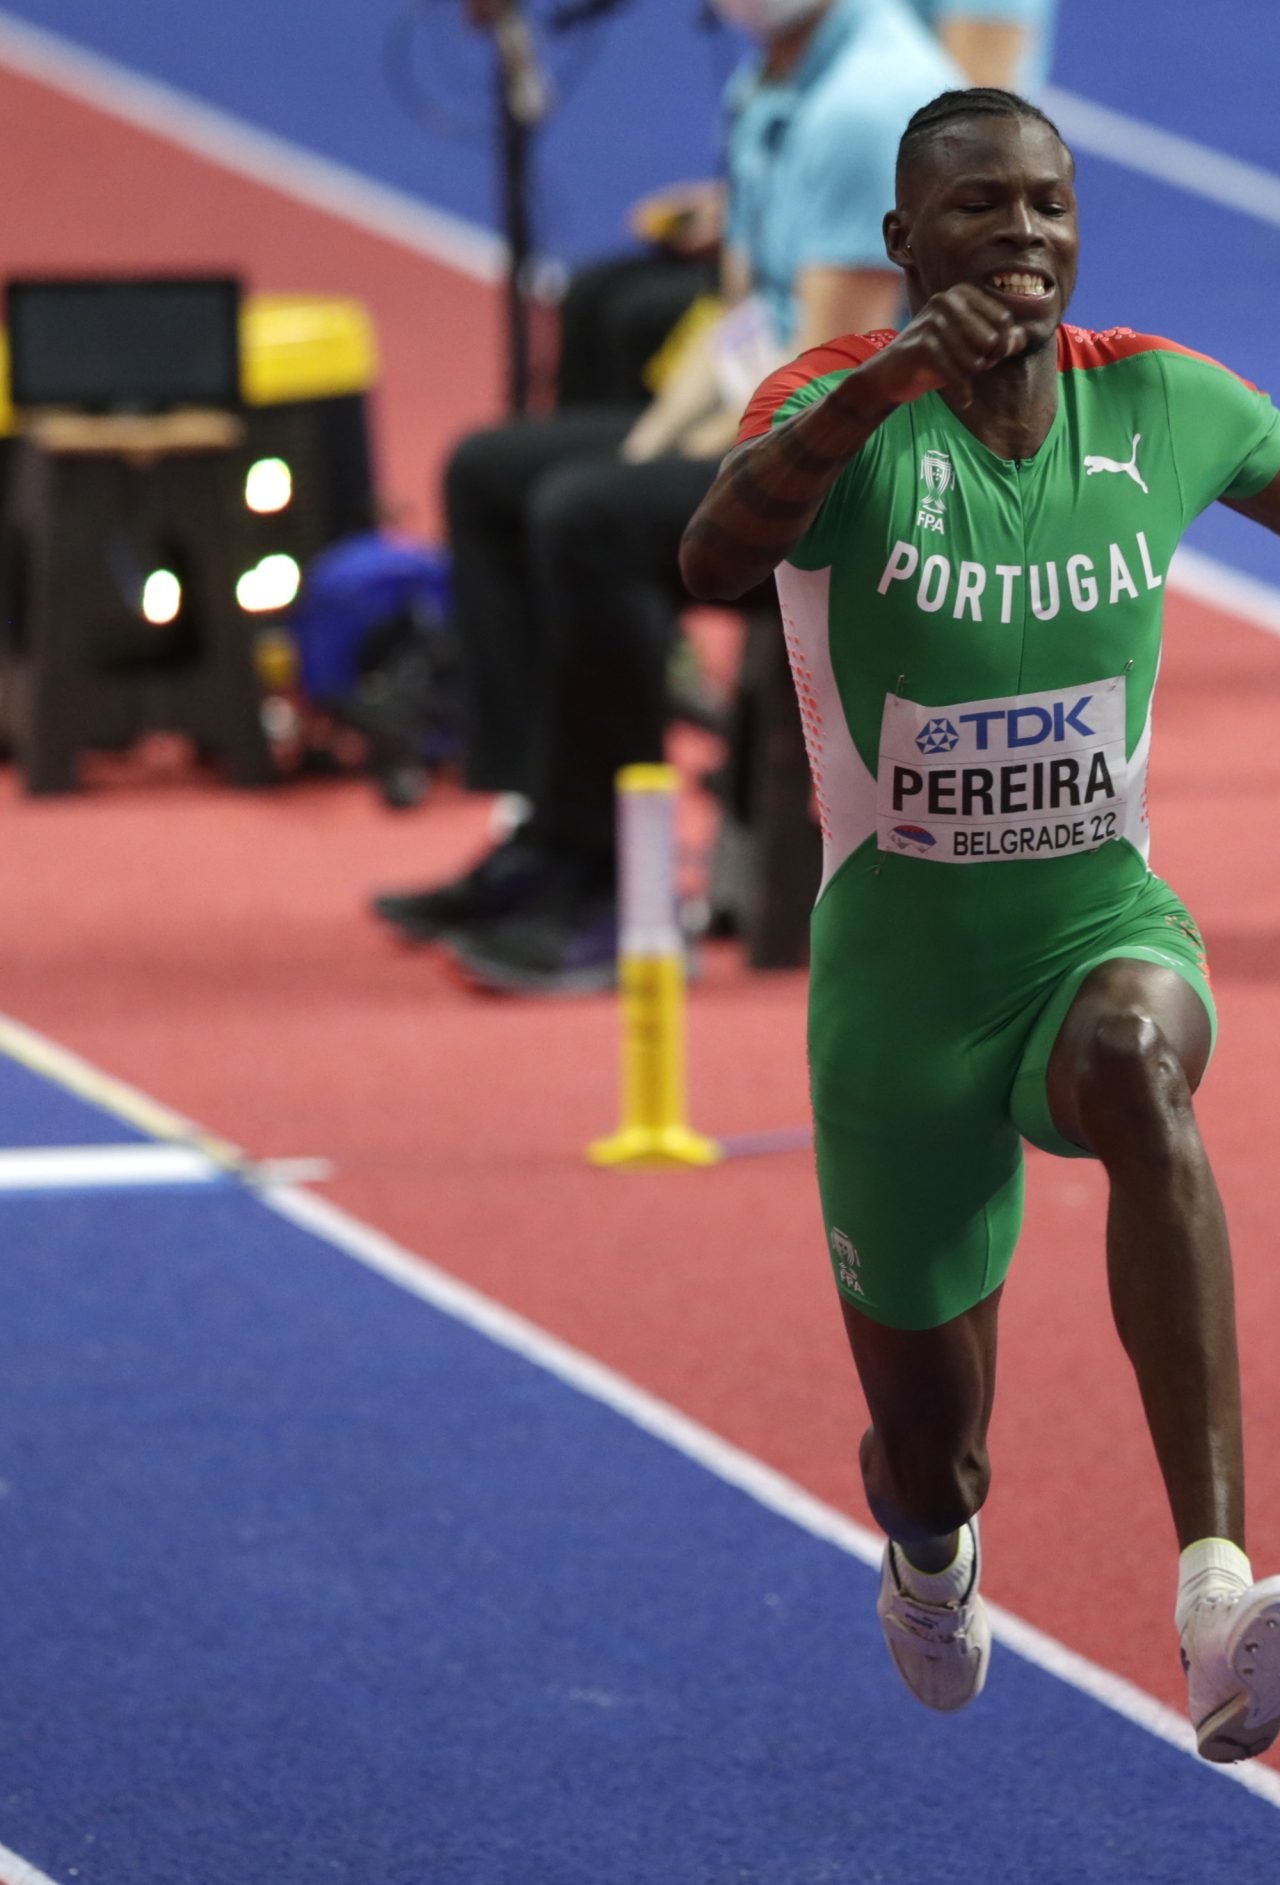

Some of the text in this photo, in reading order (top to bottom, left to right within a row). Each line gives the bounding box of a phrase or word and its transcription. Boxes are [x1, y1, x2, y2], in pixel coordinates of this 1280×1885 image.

[917, 511, 945, 535] FPA
[878, 532, 1162, 624] PORTUGAL
[960, 697, 1096, 750] TDK
[893, 751, 1115, 816] PEREIRA
[953, 812, 1117, 857] BELGRADE 22
